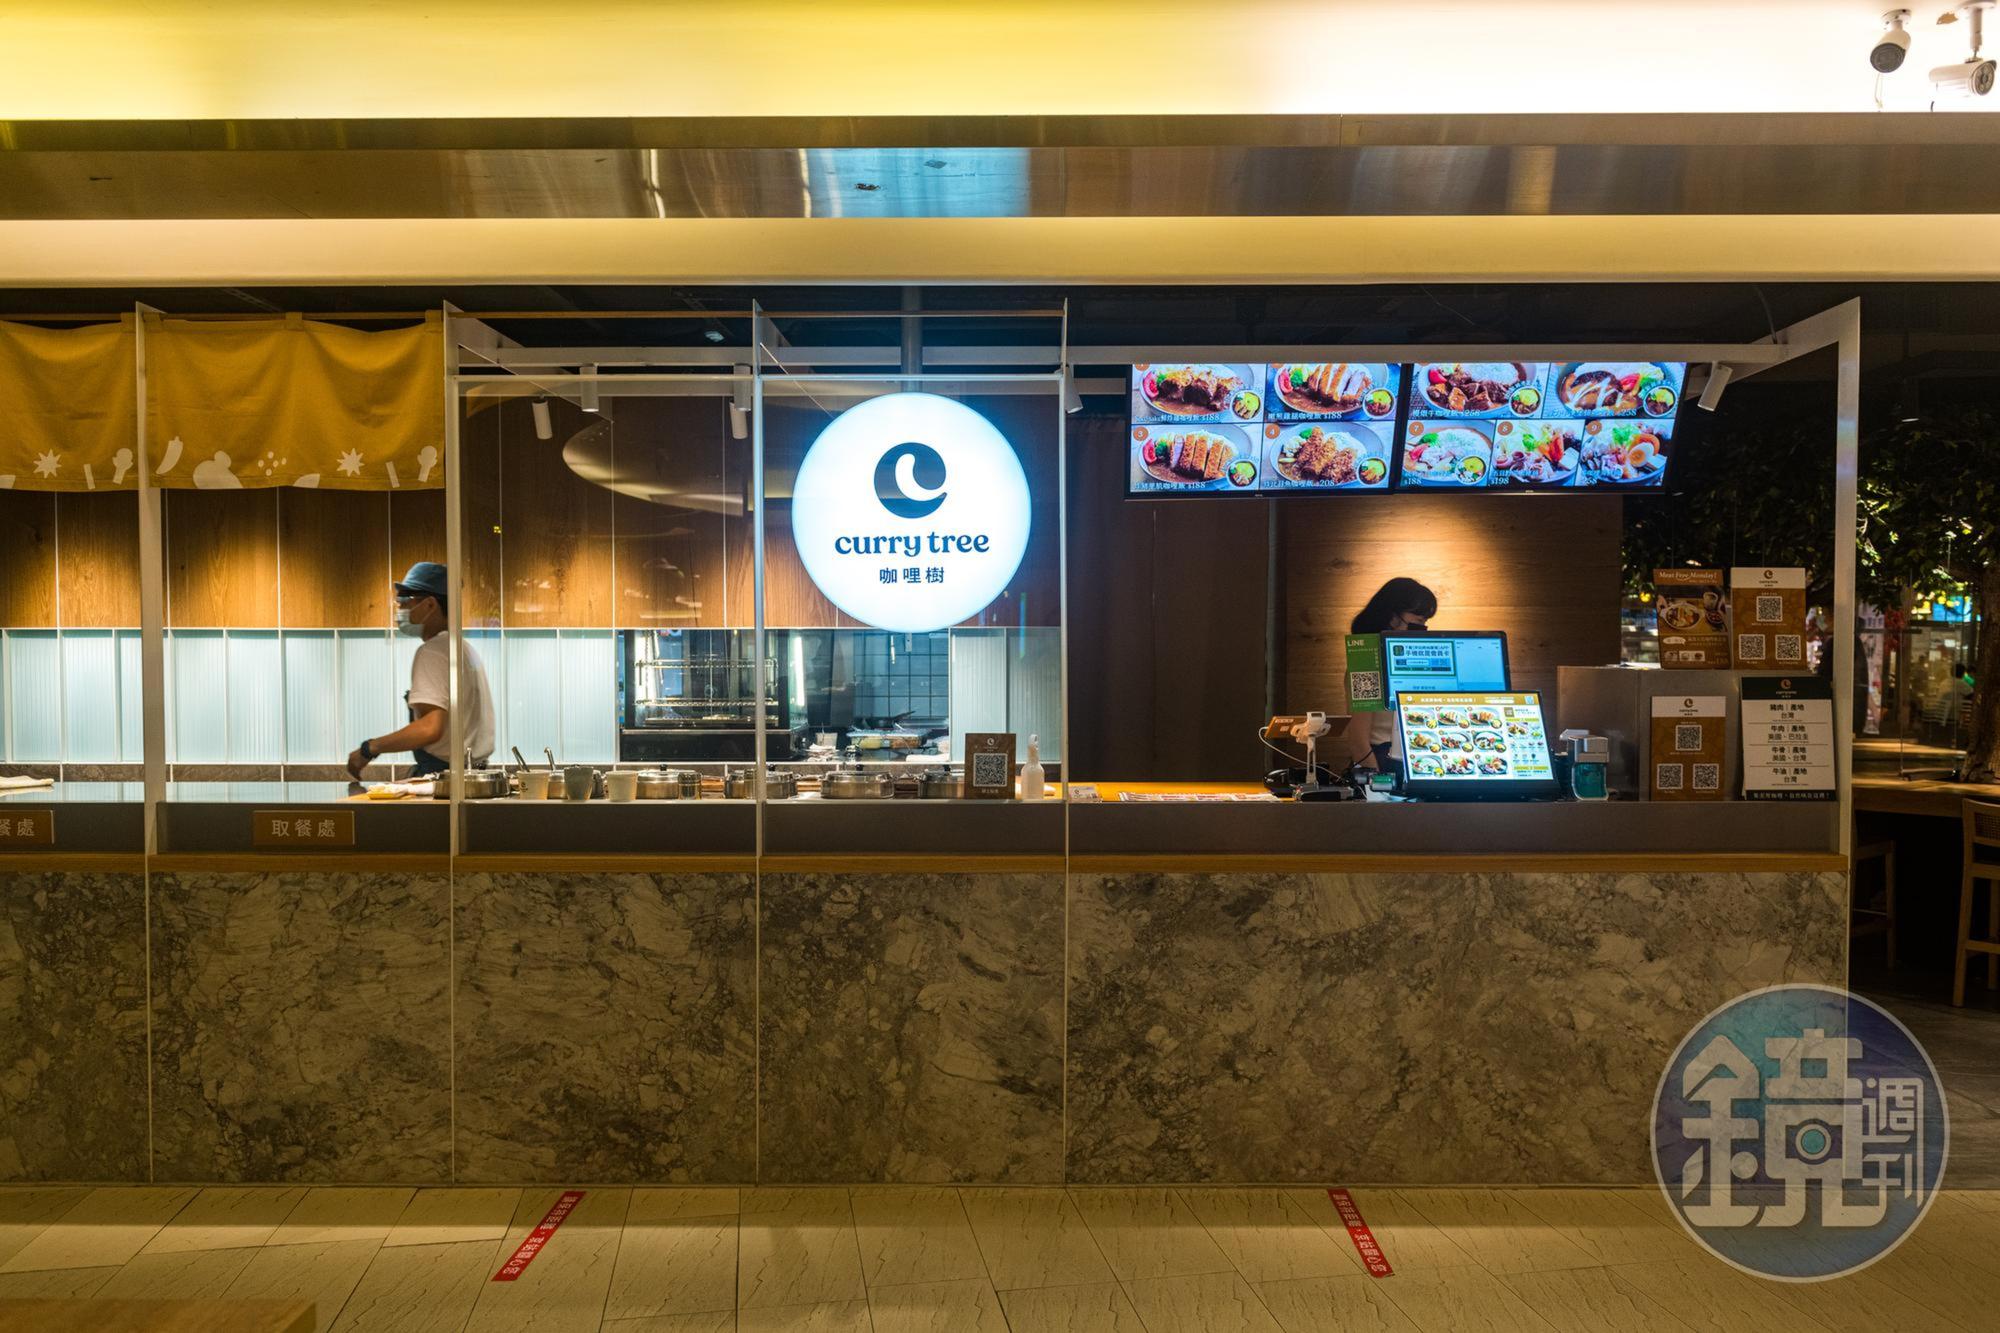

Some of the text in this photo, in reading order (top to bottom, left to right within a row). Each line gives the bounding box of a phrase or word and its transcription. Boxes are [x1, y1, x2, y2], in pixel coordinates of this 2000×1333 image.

[834, 531, 990, 558] curry tree
[879, 566, 945, 584] 咖哩樹
[1347, 639, 1365, 647] LINE
[270, 819, 337, 838] 取餐處
